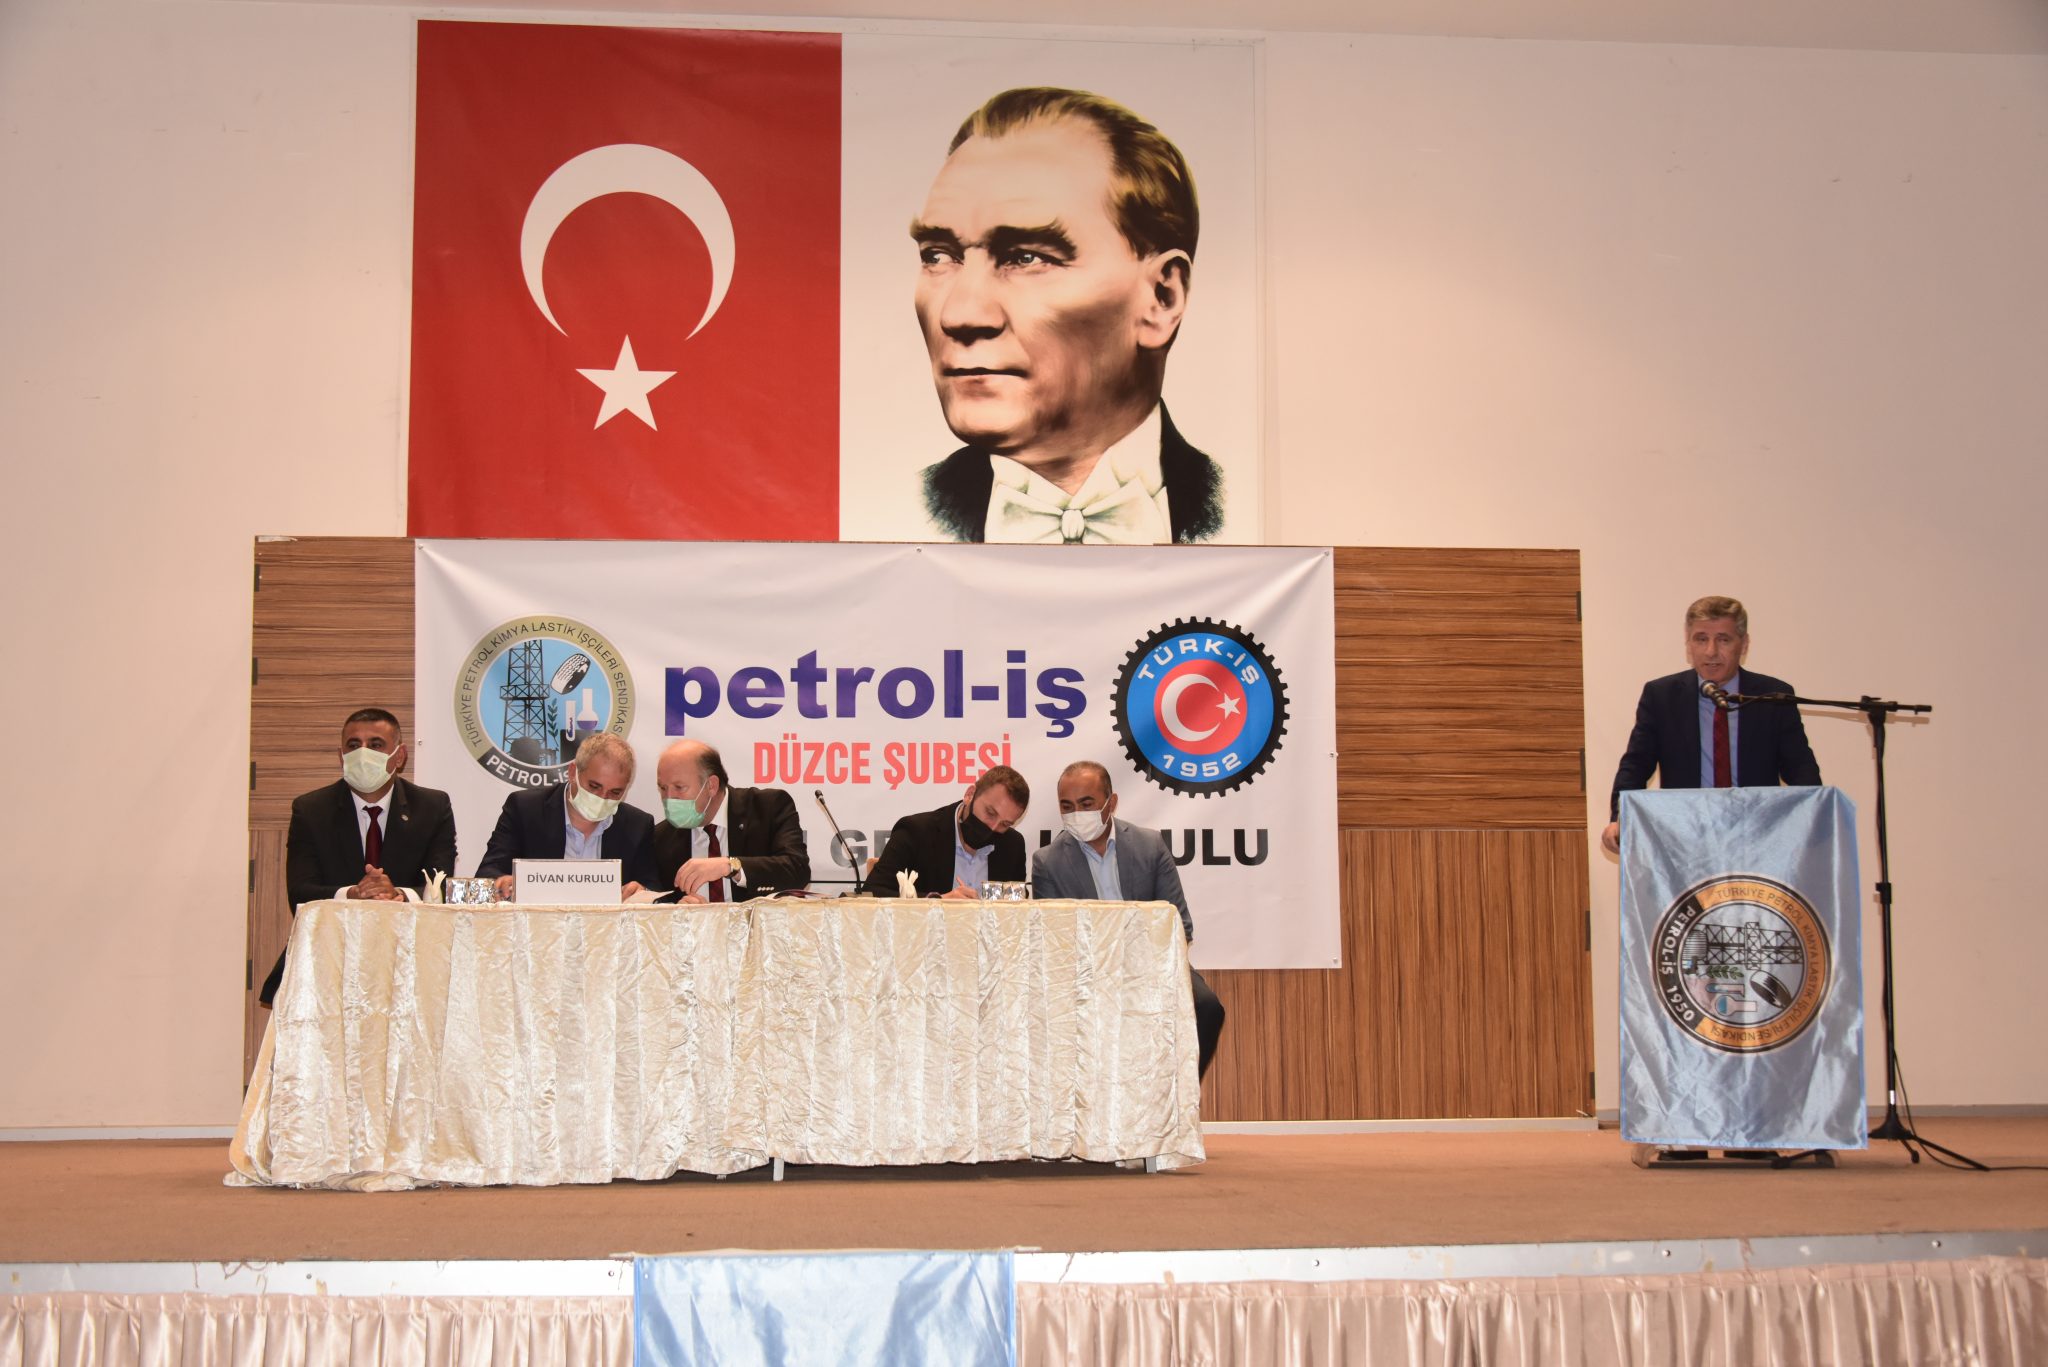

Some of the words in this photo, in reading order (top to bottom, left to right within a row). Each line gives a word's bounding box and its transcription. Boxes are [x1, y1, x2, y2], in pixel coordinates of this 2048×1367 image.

[490, 624, 530, 648] KİMYA
[531, 621, 576, 635] LASTİK
[464, 647, 497, 691] PETROL
[577, 629, 619, 671] İŞÇİLERİ
[1138, 638, 1260, 685] TÜRK-İŞ
[665, 649, 1087, 738] petrol-iş
[460, 694, 483, 747] TÜRKİYE
[754, 733, 871, 784] DÜZCE
[1163, 752, 1242, 778] 1952
[527, 872, 564, 883] DİVAN
[568, 874, 615, 883] KURULU
[1767, 892, 1803, 925] PETROL
[1666, 985, 1696, 1022] 1950
